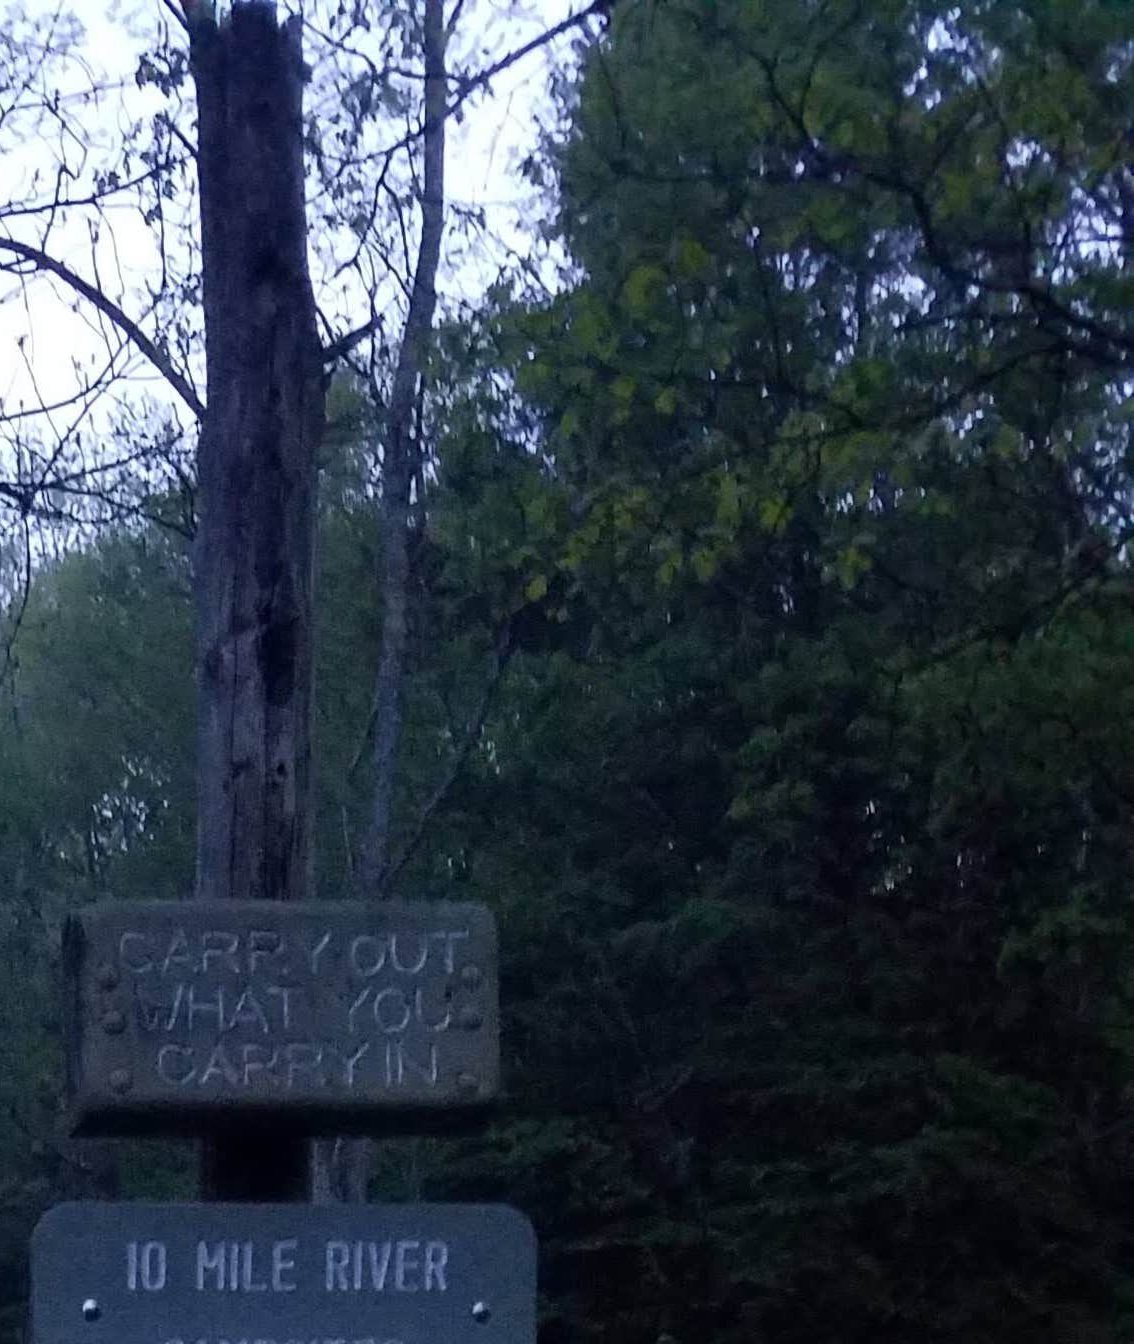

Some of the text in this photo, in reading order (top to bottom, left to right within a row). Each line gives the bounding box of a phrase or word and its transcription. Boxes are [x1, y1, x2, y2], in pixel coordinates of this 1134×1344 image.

[350, 929, 470, 977] OUT
[134, 984, 452, 1034] WHAT YOU
[384, 1042, 439, 1089] IN
[126, 1240, 449, 1292] 10 MILE RIVER
